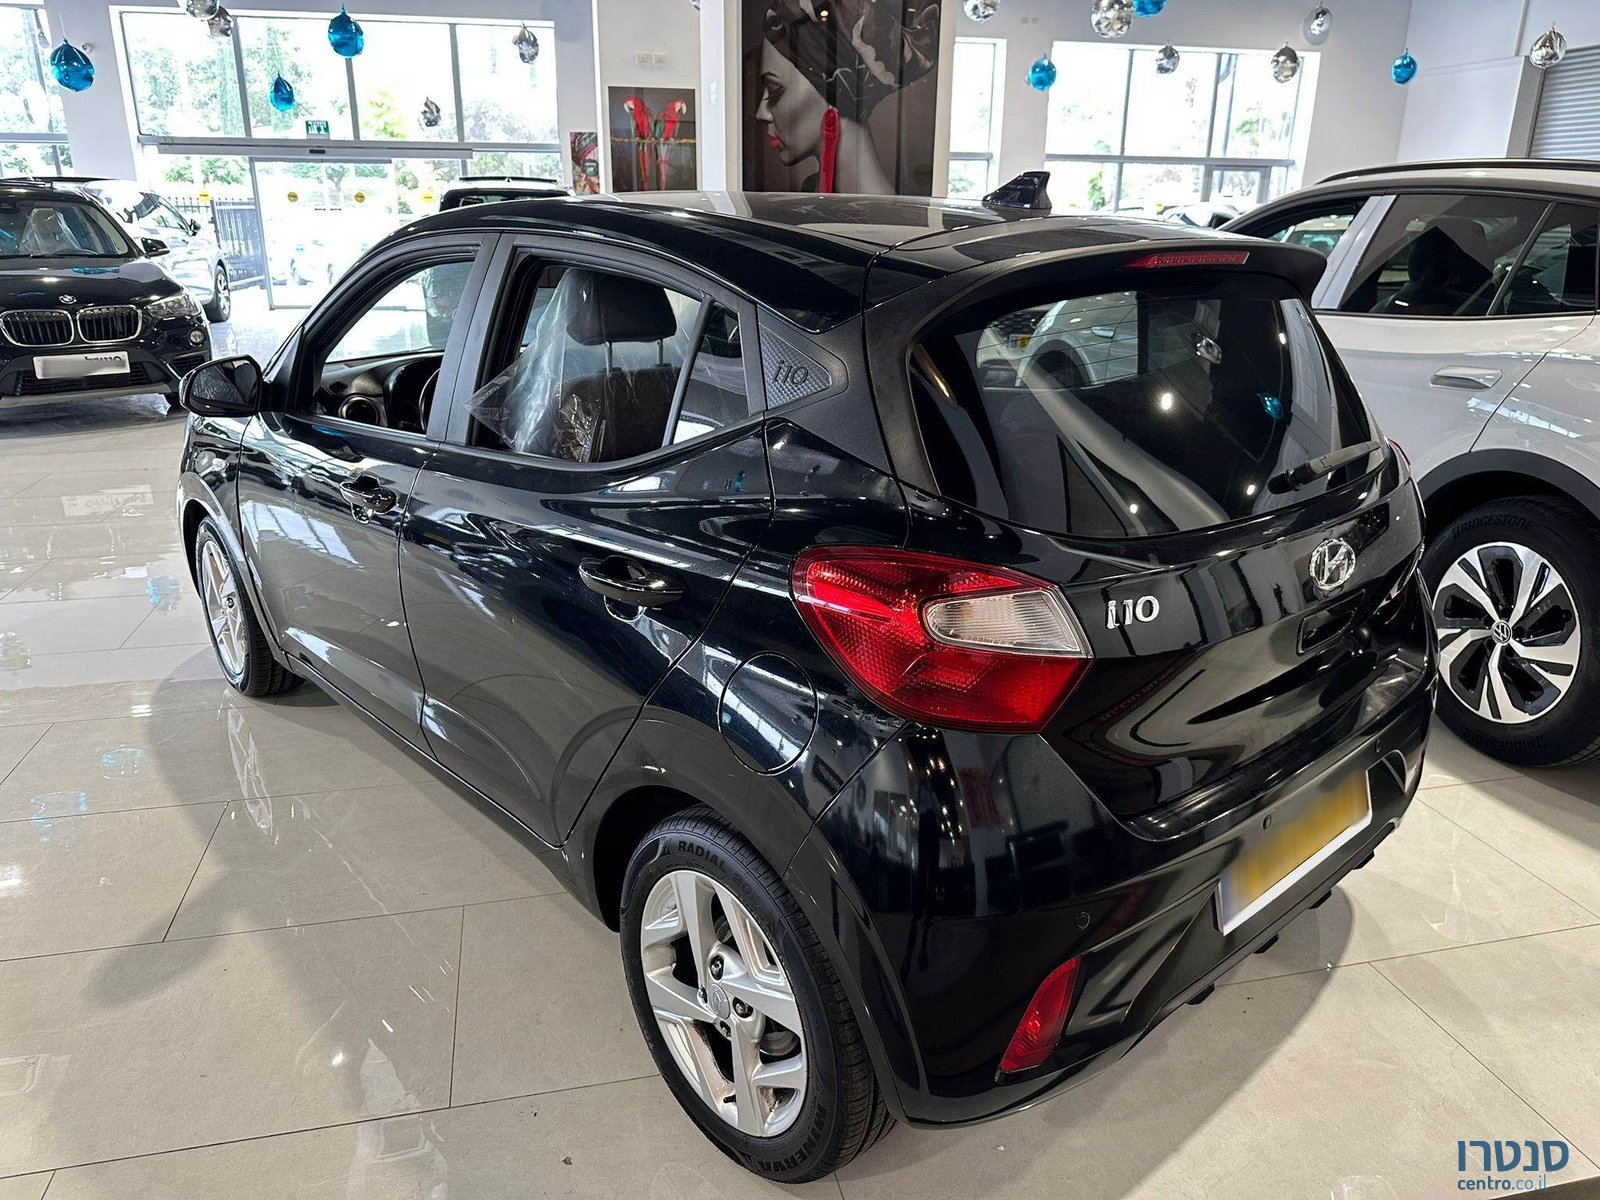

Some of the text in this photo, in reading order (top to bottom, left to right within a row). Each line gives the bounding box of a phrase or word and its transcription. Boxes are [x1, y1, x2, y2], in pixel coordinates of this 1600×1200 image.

[772, 360, 808, 386] i10
[1451, 513, 1536, 539] BRIDGESTONE
[1106, 595, 1160, 630] i10
[758, 1103, 827, 1173] MINERVA
